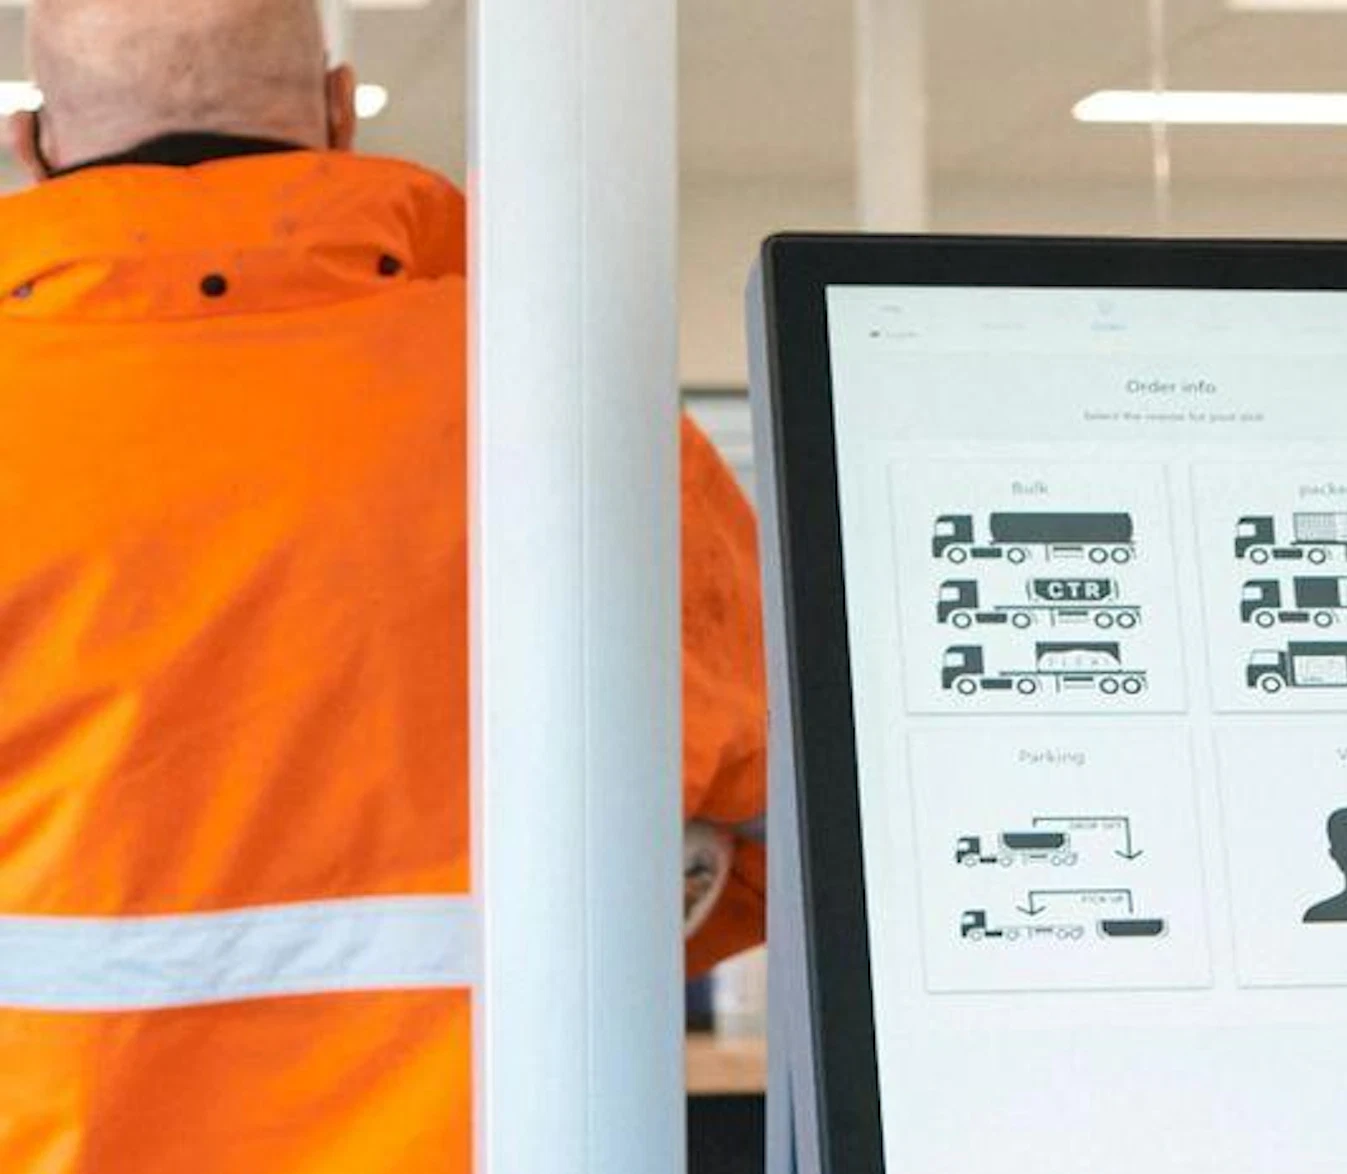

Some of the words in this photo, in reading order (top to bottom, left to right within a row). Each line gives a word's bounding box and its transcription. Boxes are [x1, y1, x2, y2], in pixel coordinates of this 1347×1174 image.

[1125, 379, 1175, 394] Order
[1180, 379, 1217, 394] info
[1011, 480, 1048, 497] Bulk
[1048, 581, 1100, 599] CTR
[1018, 748, 1086, 768] Parking
